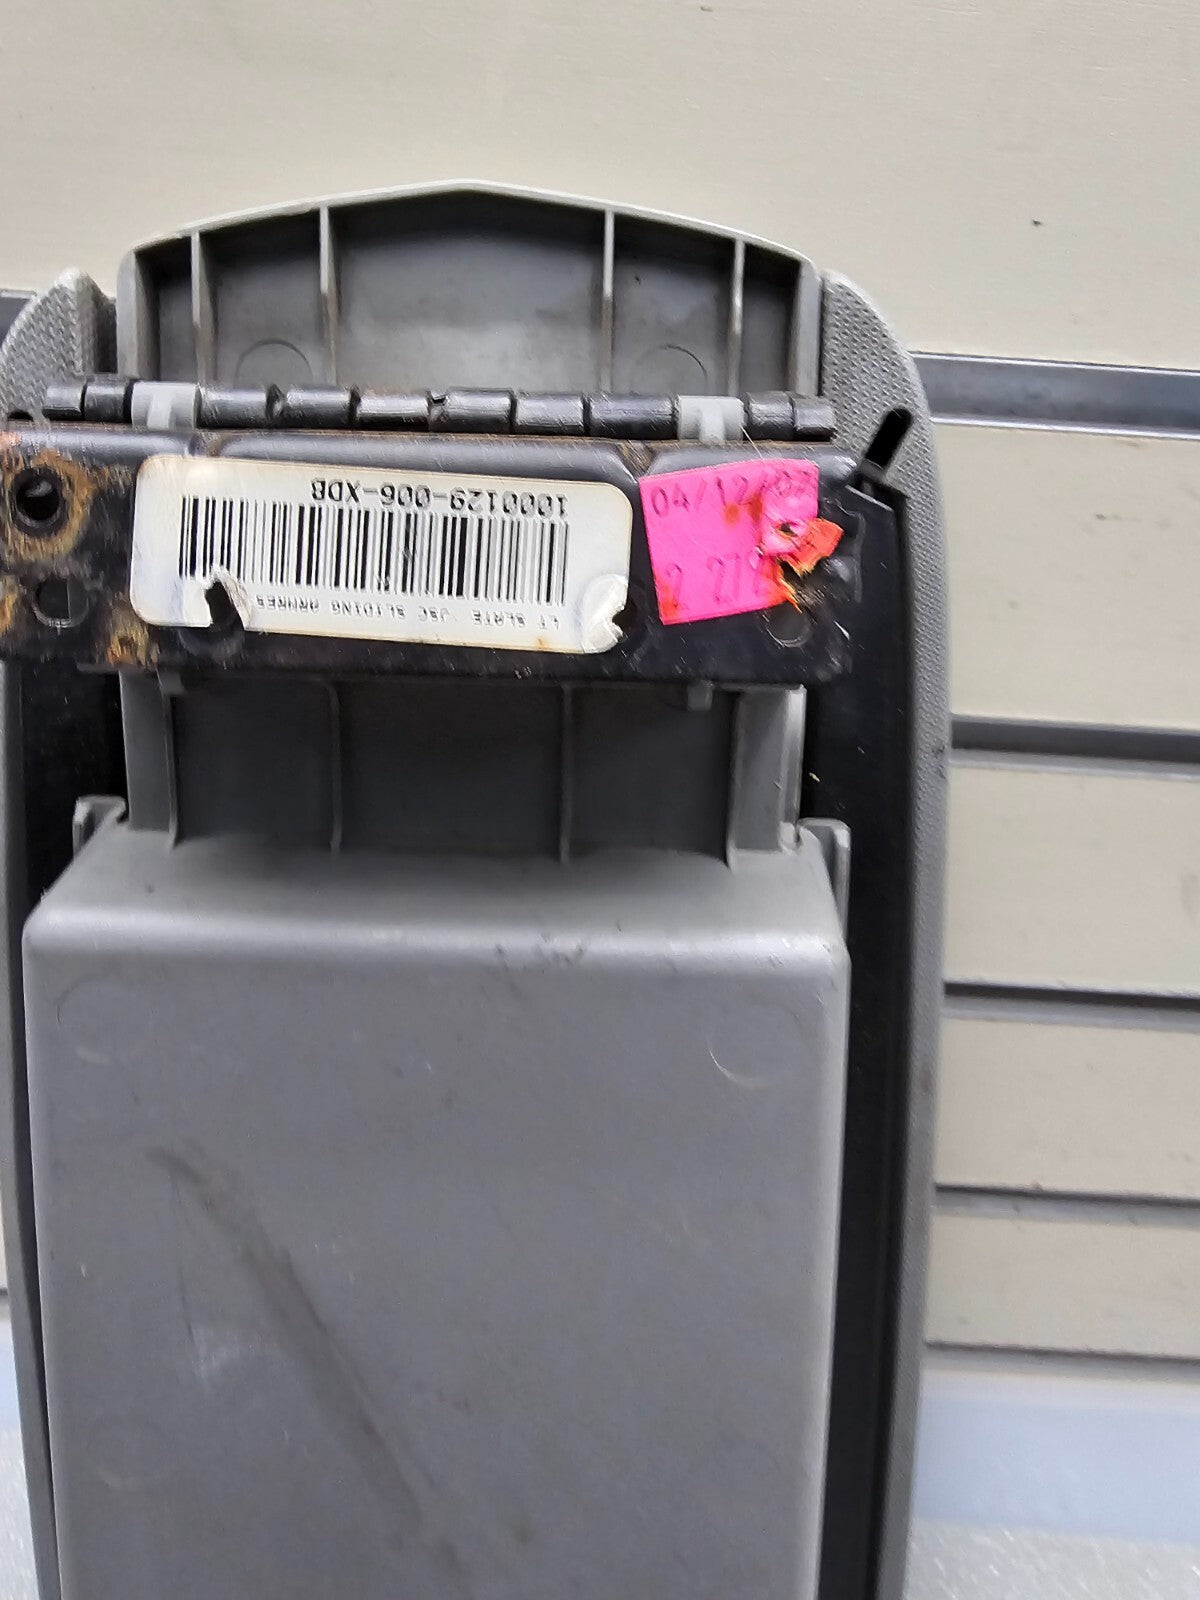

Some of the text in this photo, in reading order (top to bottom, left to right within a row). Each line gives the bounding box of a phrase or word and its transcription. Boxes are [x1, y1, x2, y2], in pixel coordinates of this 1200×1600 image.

[311, 477, 568, 518] 1000129-006-XDB
[331, 601, 406, 619] SLIDING
[472, 609, 526, 628] SLATE
